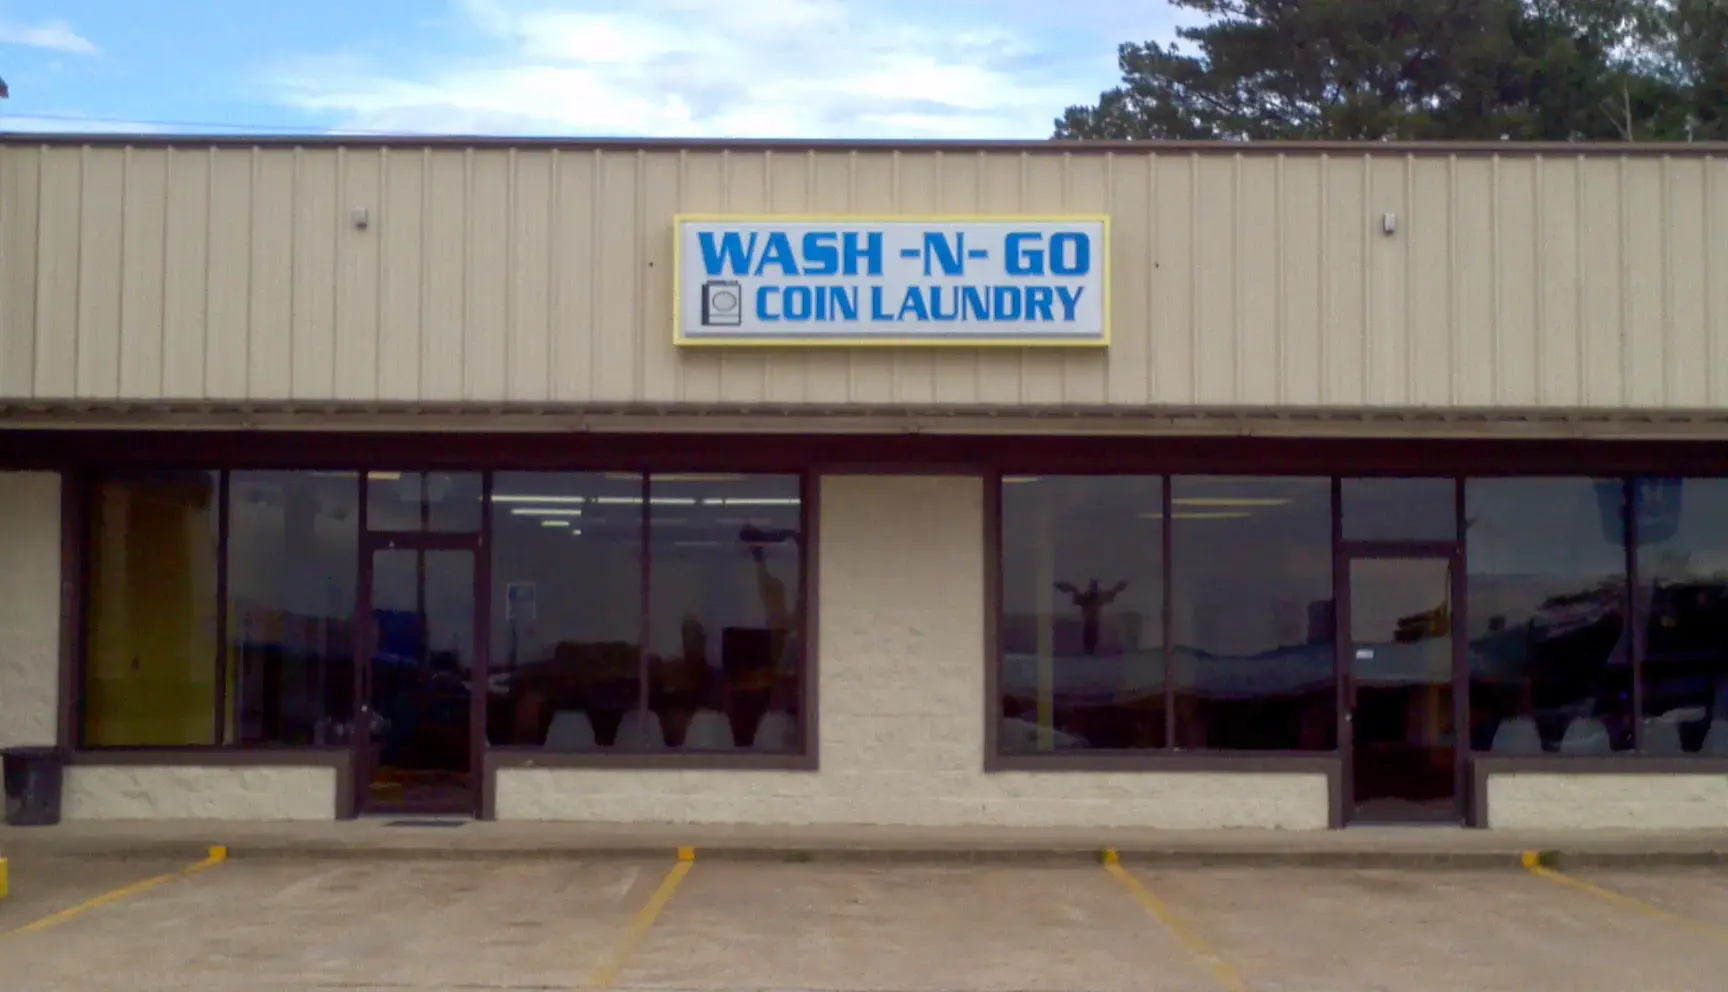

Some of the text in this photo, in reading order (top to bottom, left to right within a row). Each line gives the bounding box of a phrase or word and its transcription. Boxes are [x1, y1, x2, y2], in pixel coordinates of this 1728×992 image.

[697, 231, 1090, 276] WASH -N- GO
[755, 285, 1085, 321] COIN LAUNDRY
